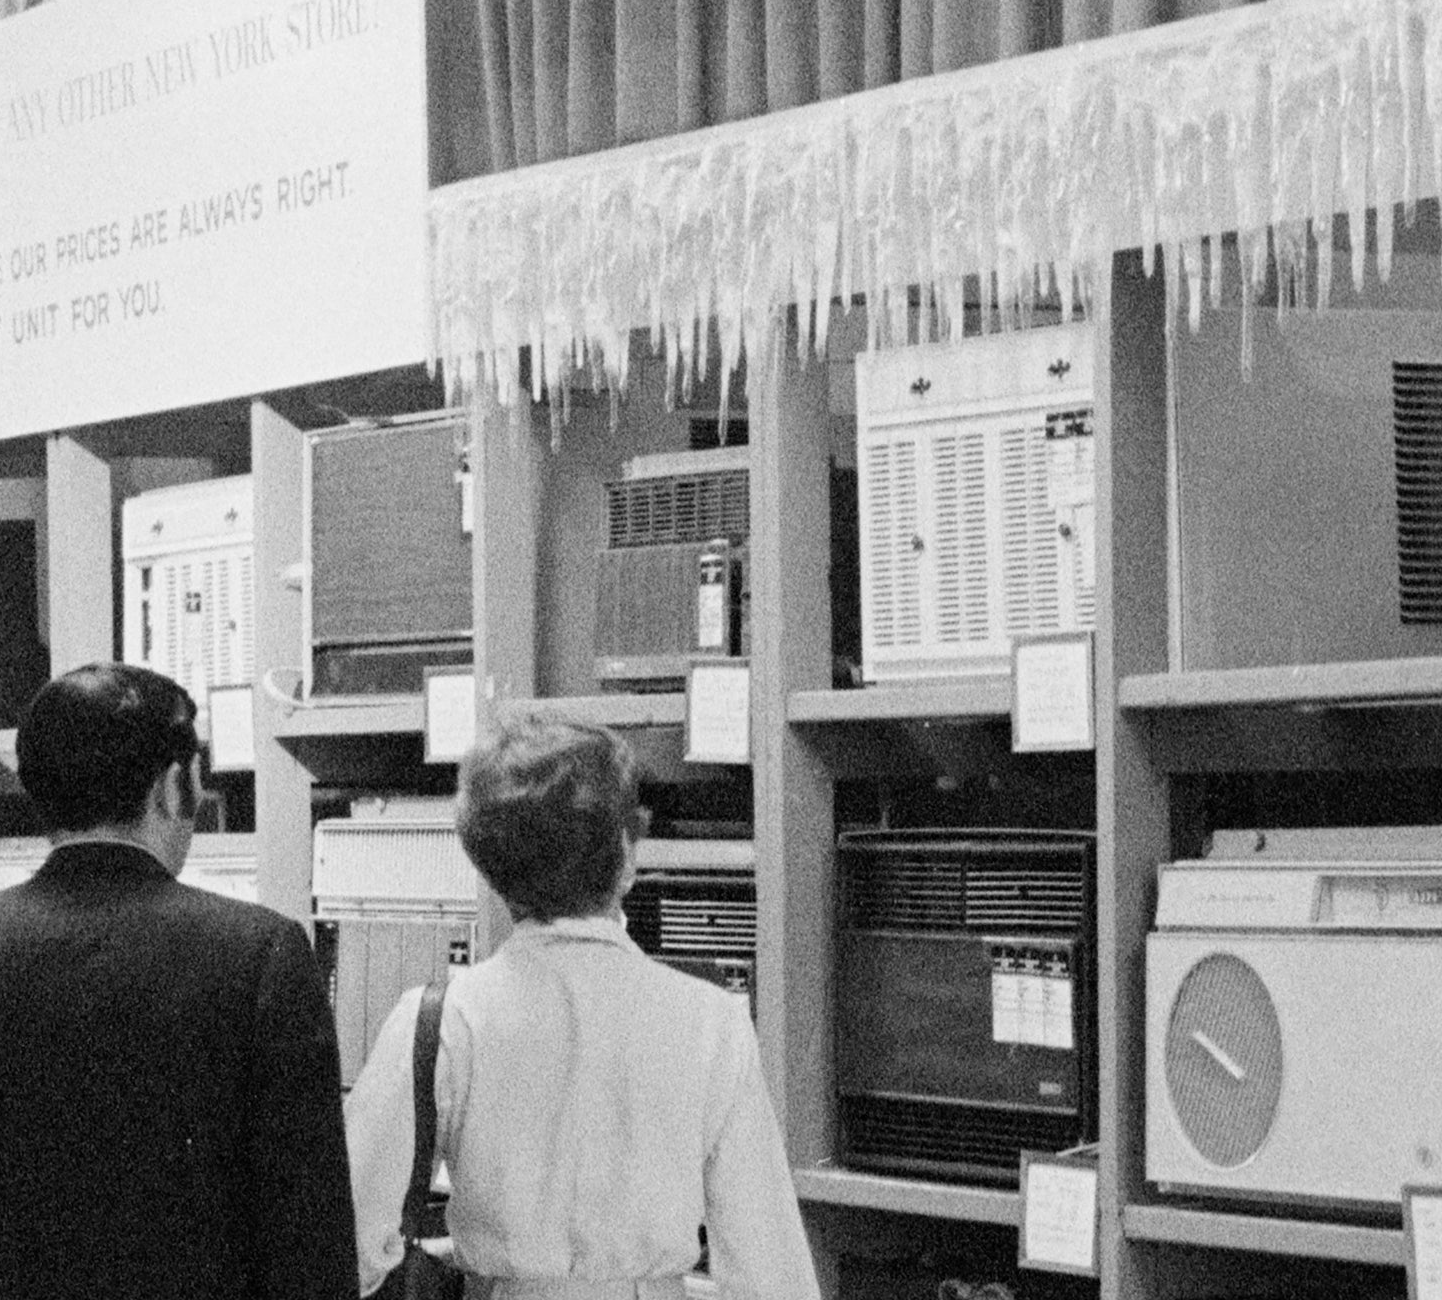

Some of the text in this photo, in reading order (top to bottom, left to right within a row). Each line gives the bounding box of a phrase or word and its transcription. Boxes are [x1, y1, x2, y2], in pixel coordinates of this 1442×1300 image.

[7, 86, 50, 143] ANY
[56, 61, 137, 128] OTHER
[144, 36, 201, 102] NEW
[207, 12, 277, 81] YORK
[9, 240, 48, 283] OUR
[54, 219, 122, 272] PRICES
[128, 207, 170, 252] ARE
[177, 181, 265, 241] ALWAYS
[275, 158, 356, 216] RIGHT.
[10, 300, 61, 346] UNIT
[69, 289, 113, 335] FOR
[117, 278, 168, 322] YOU.
